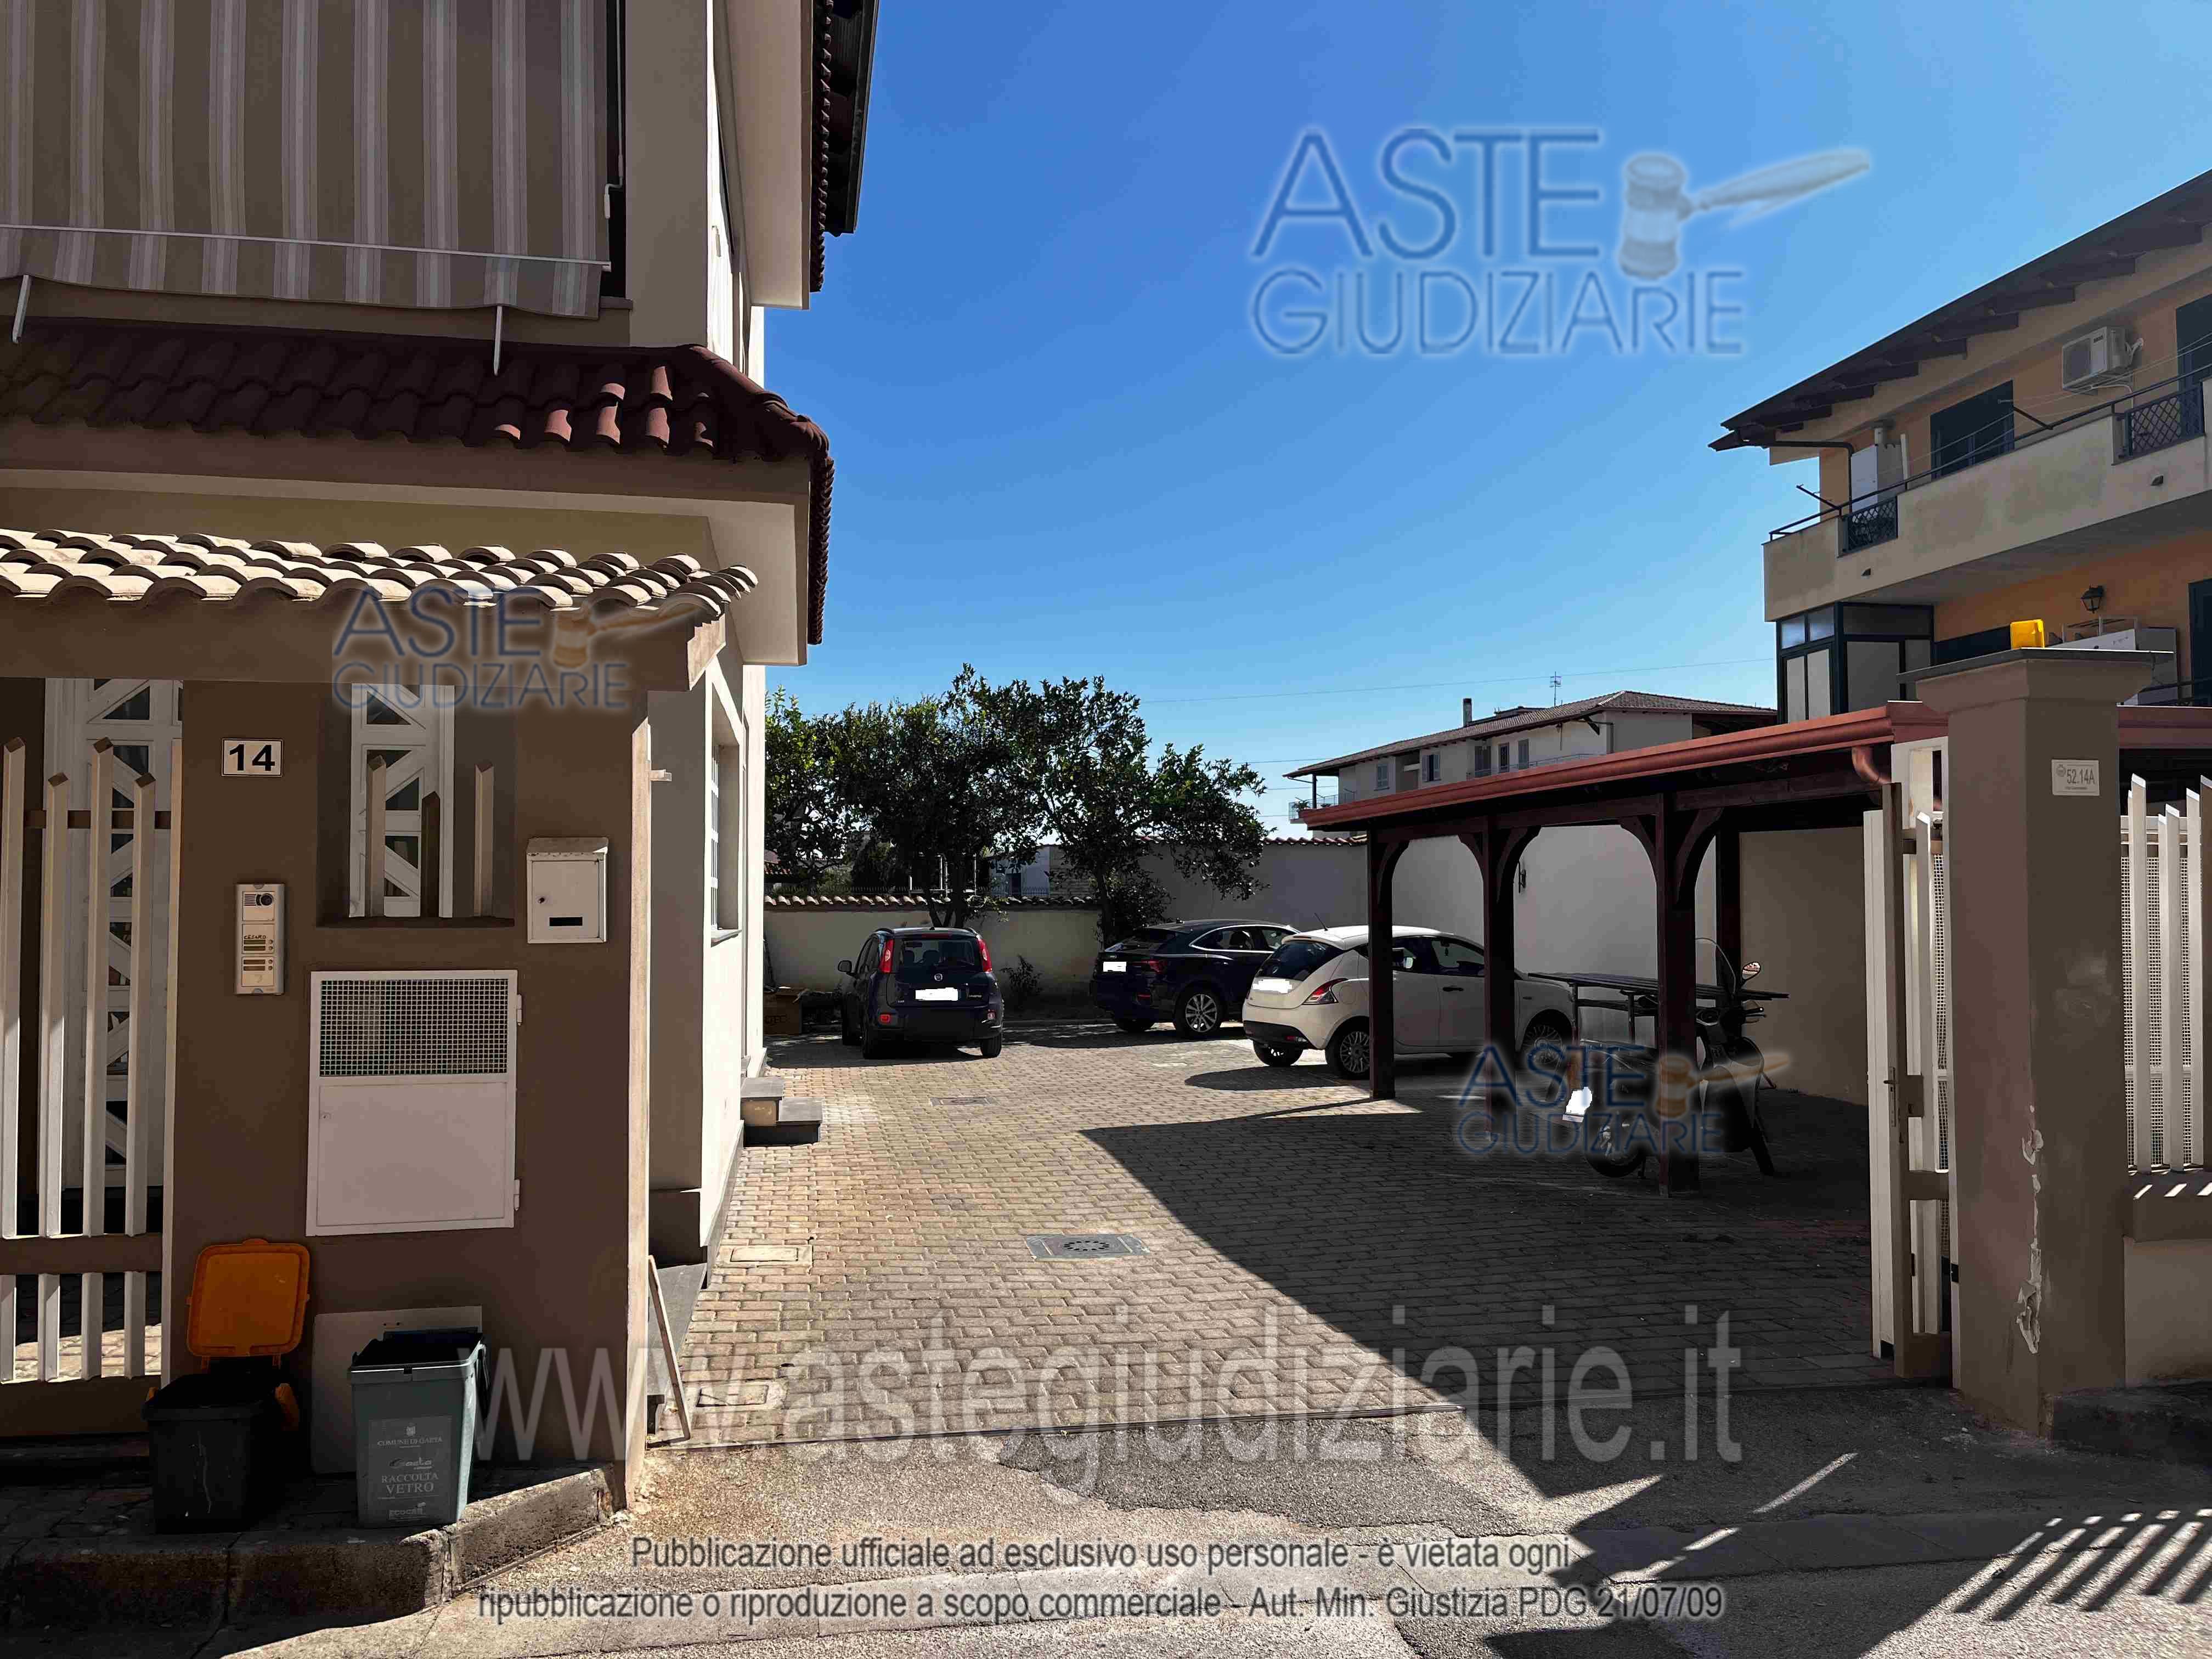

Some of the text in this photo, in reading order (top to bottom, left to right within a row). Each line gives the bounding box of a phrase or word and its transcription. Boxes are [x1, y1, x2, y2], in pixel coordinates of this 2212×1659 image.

[228, 743, 276, 771] 14
[381, 1472, 439, 1483] RACCOLTA
[386, 1482, 434, 1494] VETRO
